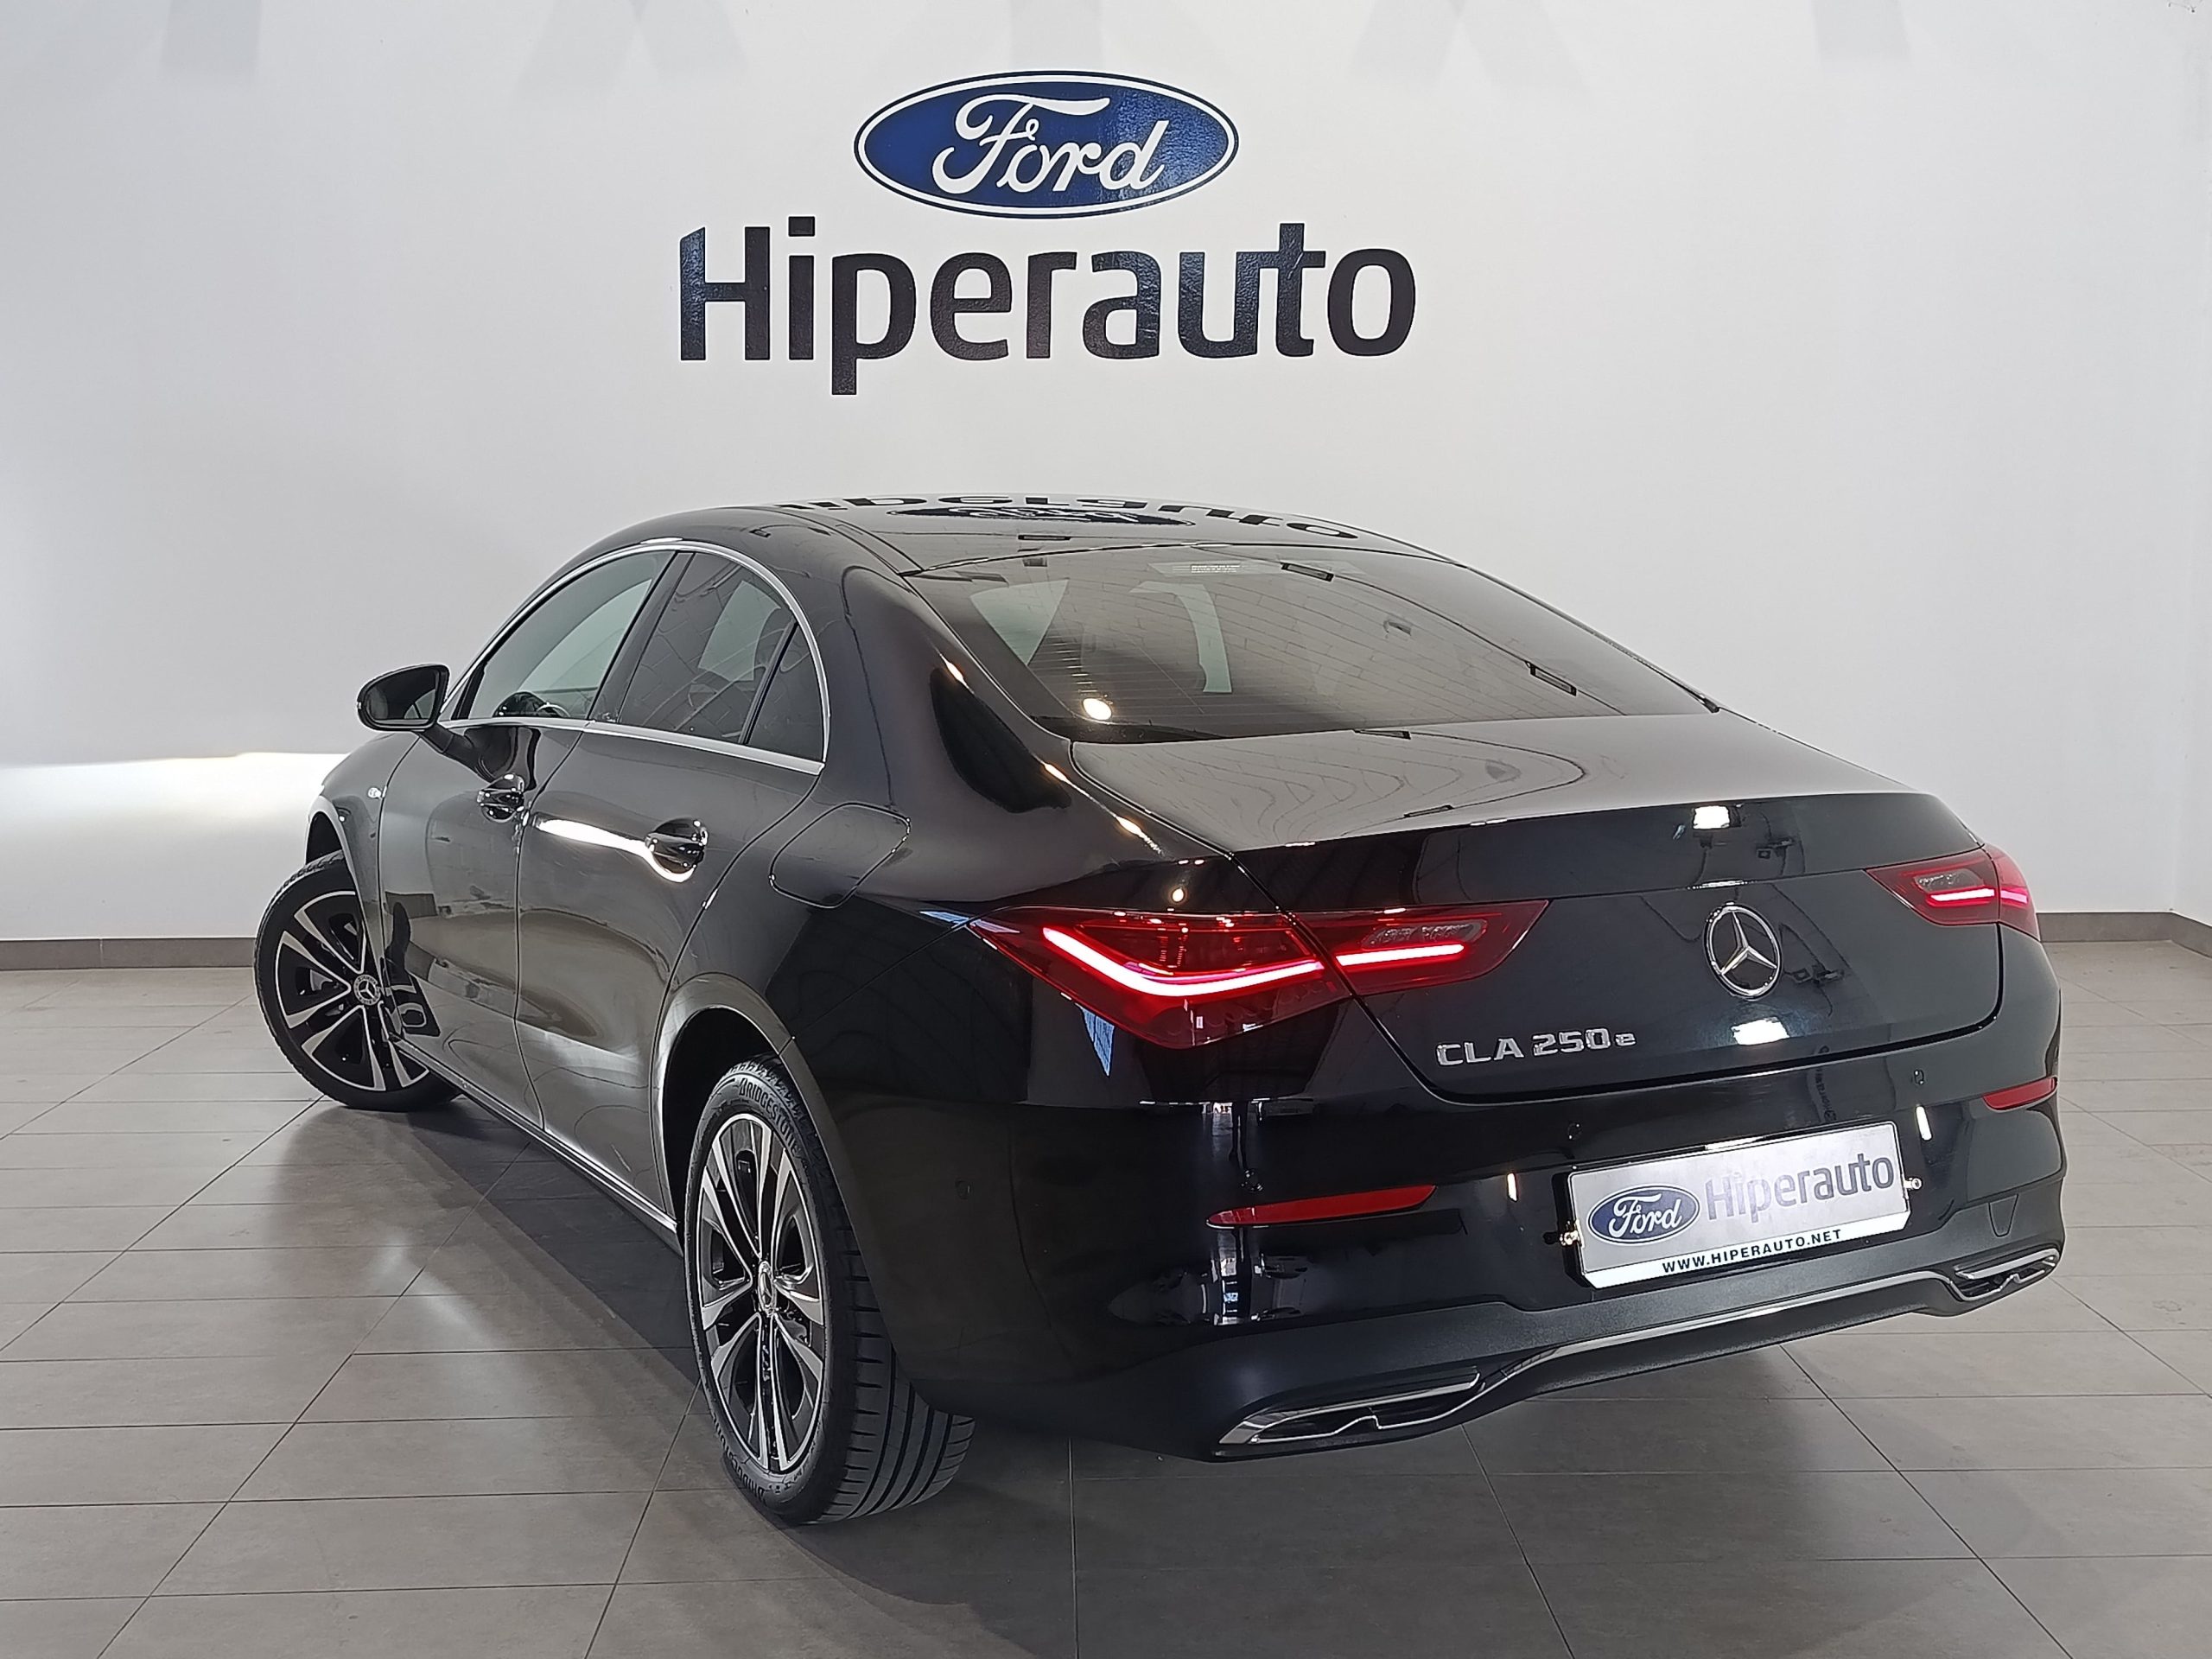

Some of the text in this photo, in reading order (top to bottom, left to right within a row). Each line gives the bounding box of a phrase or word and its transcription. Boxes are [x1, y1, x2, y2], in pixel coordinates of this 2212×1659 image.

[931, 93, 1168, 194] Ford
[679, 215, 1415, 395] Hiperauto
[1435, 1038, 1525, 1066] CLA
[1608, 1193, 1682, 1237] Ford
[1705, 1153, 1894, 1223] Hiperauto
[1662, 1229, 1842, 1273] WWW.HIPERAUTO.NET
